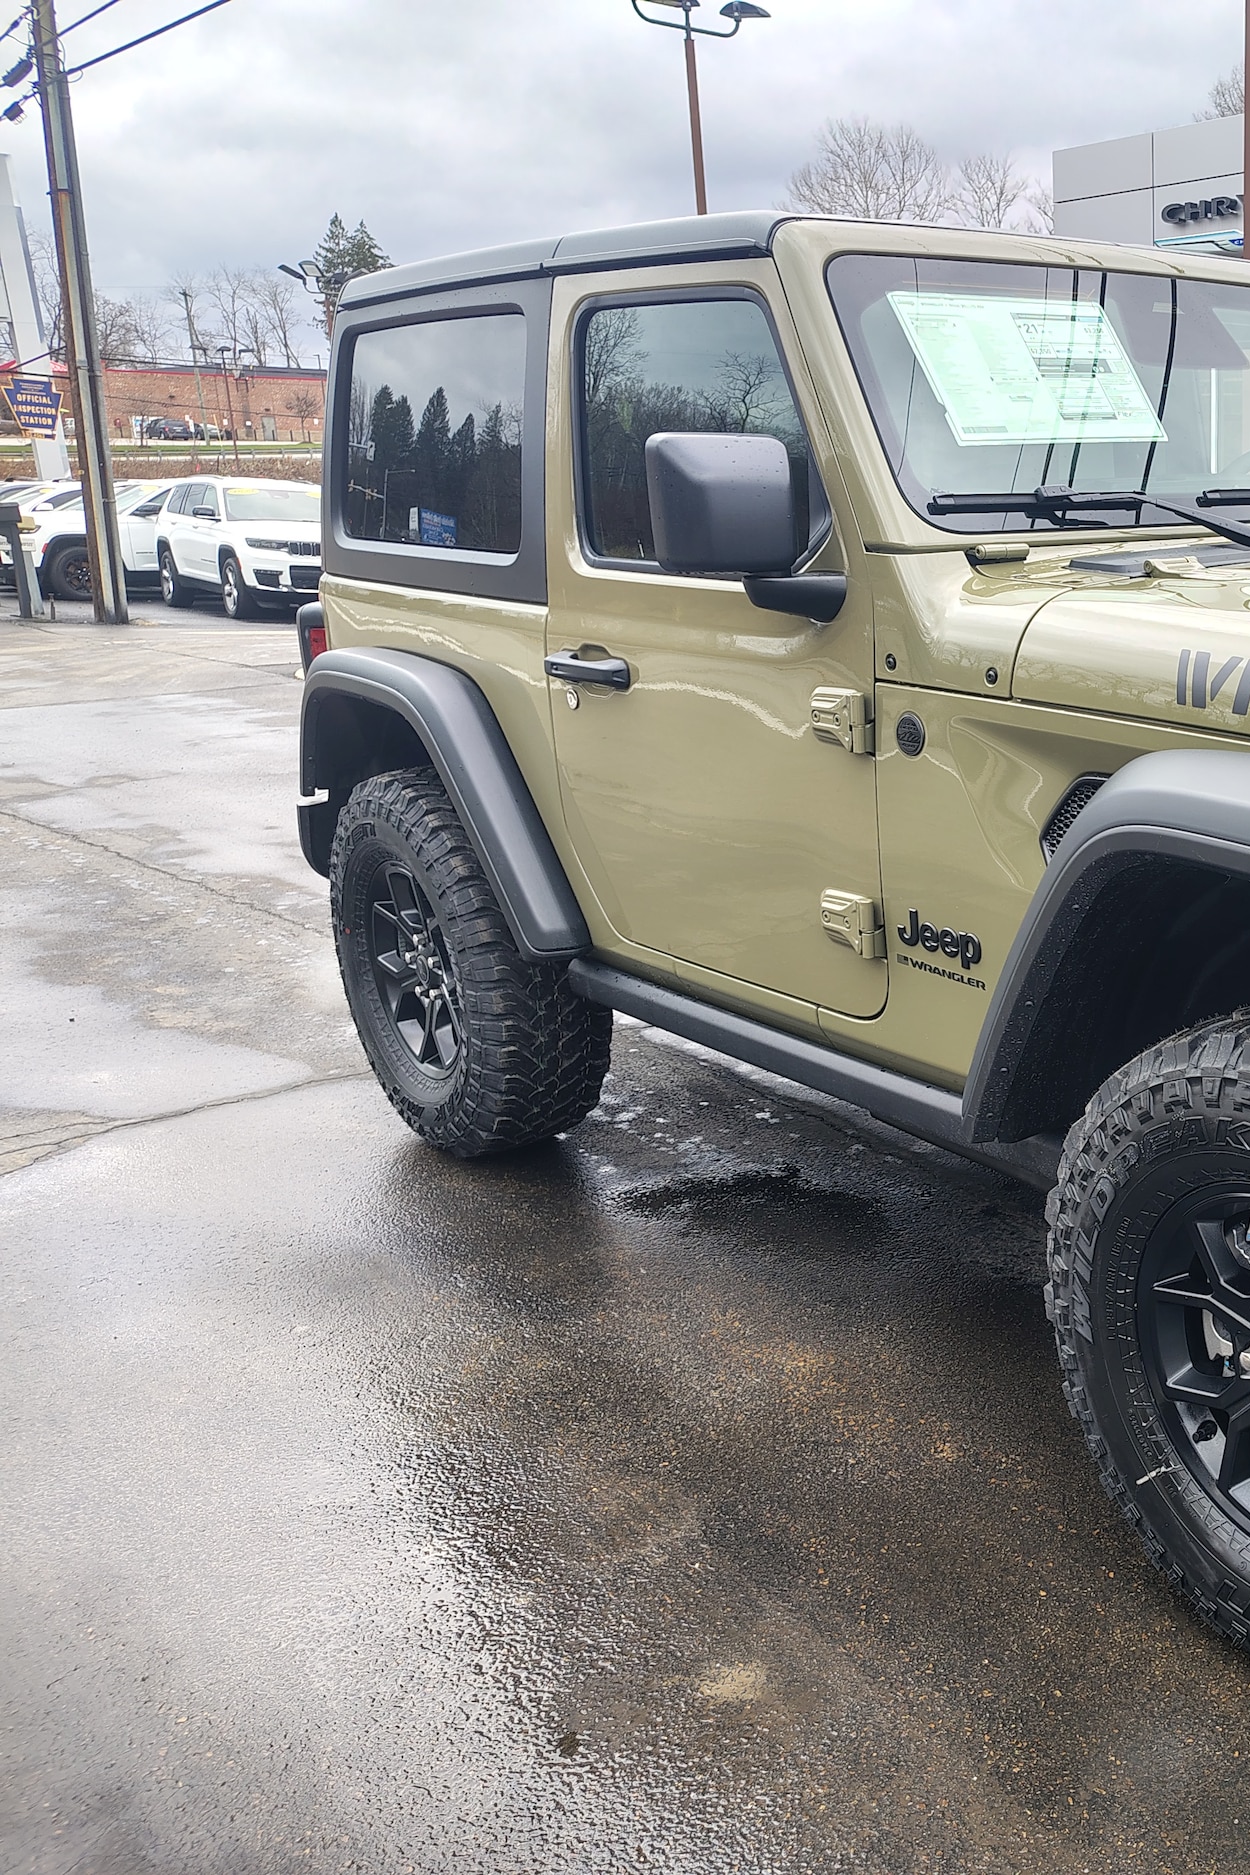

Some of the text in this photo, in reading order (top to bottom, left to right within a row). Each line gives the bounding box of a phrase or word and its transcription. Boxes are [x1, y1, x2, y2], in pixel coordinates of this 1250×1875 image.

[16, 394, 52, 404] OFFICIAL
[13, 405, 56, 415] INSPECTION
[20, 416, 52, 425] STATION
[897, 907, 982, 970] Jeep
[909, 957, 987, 991] WRANGLER
